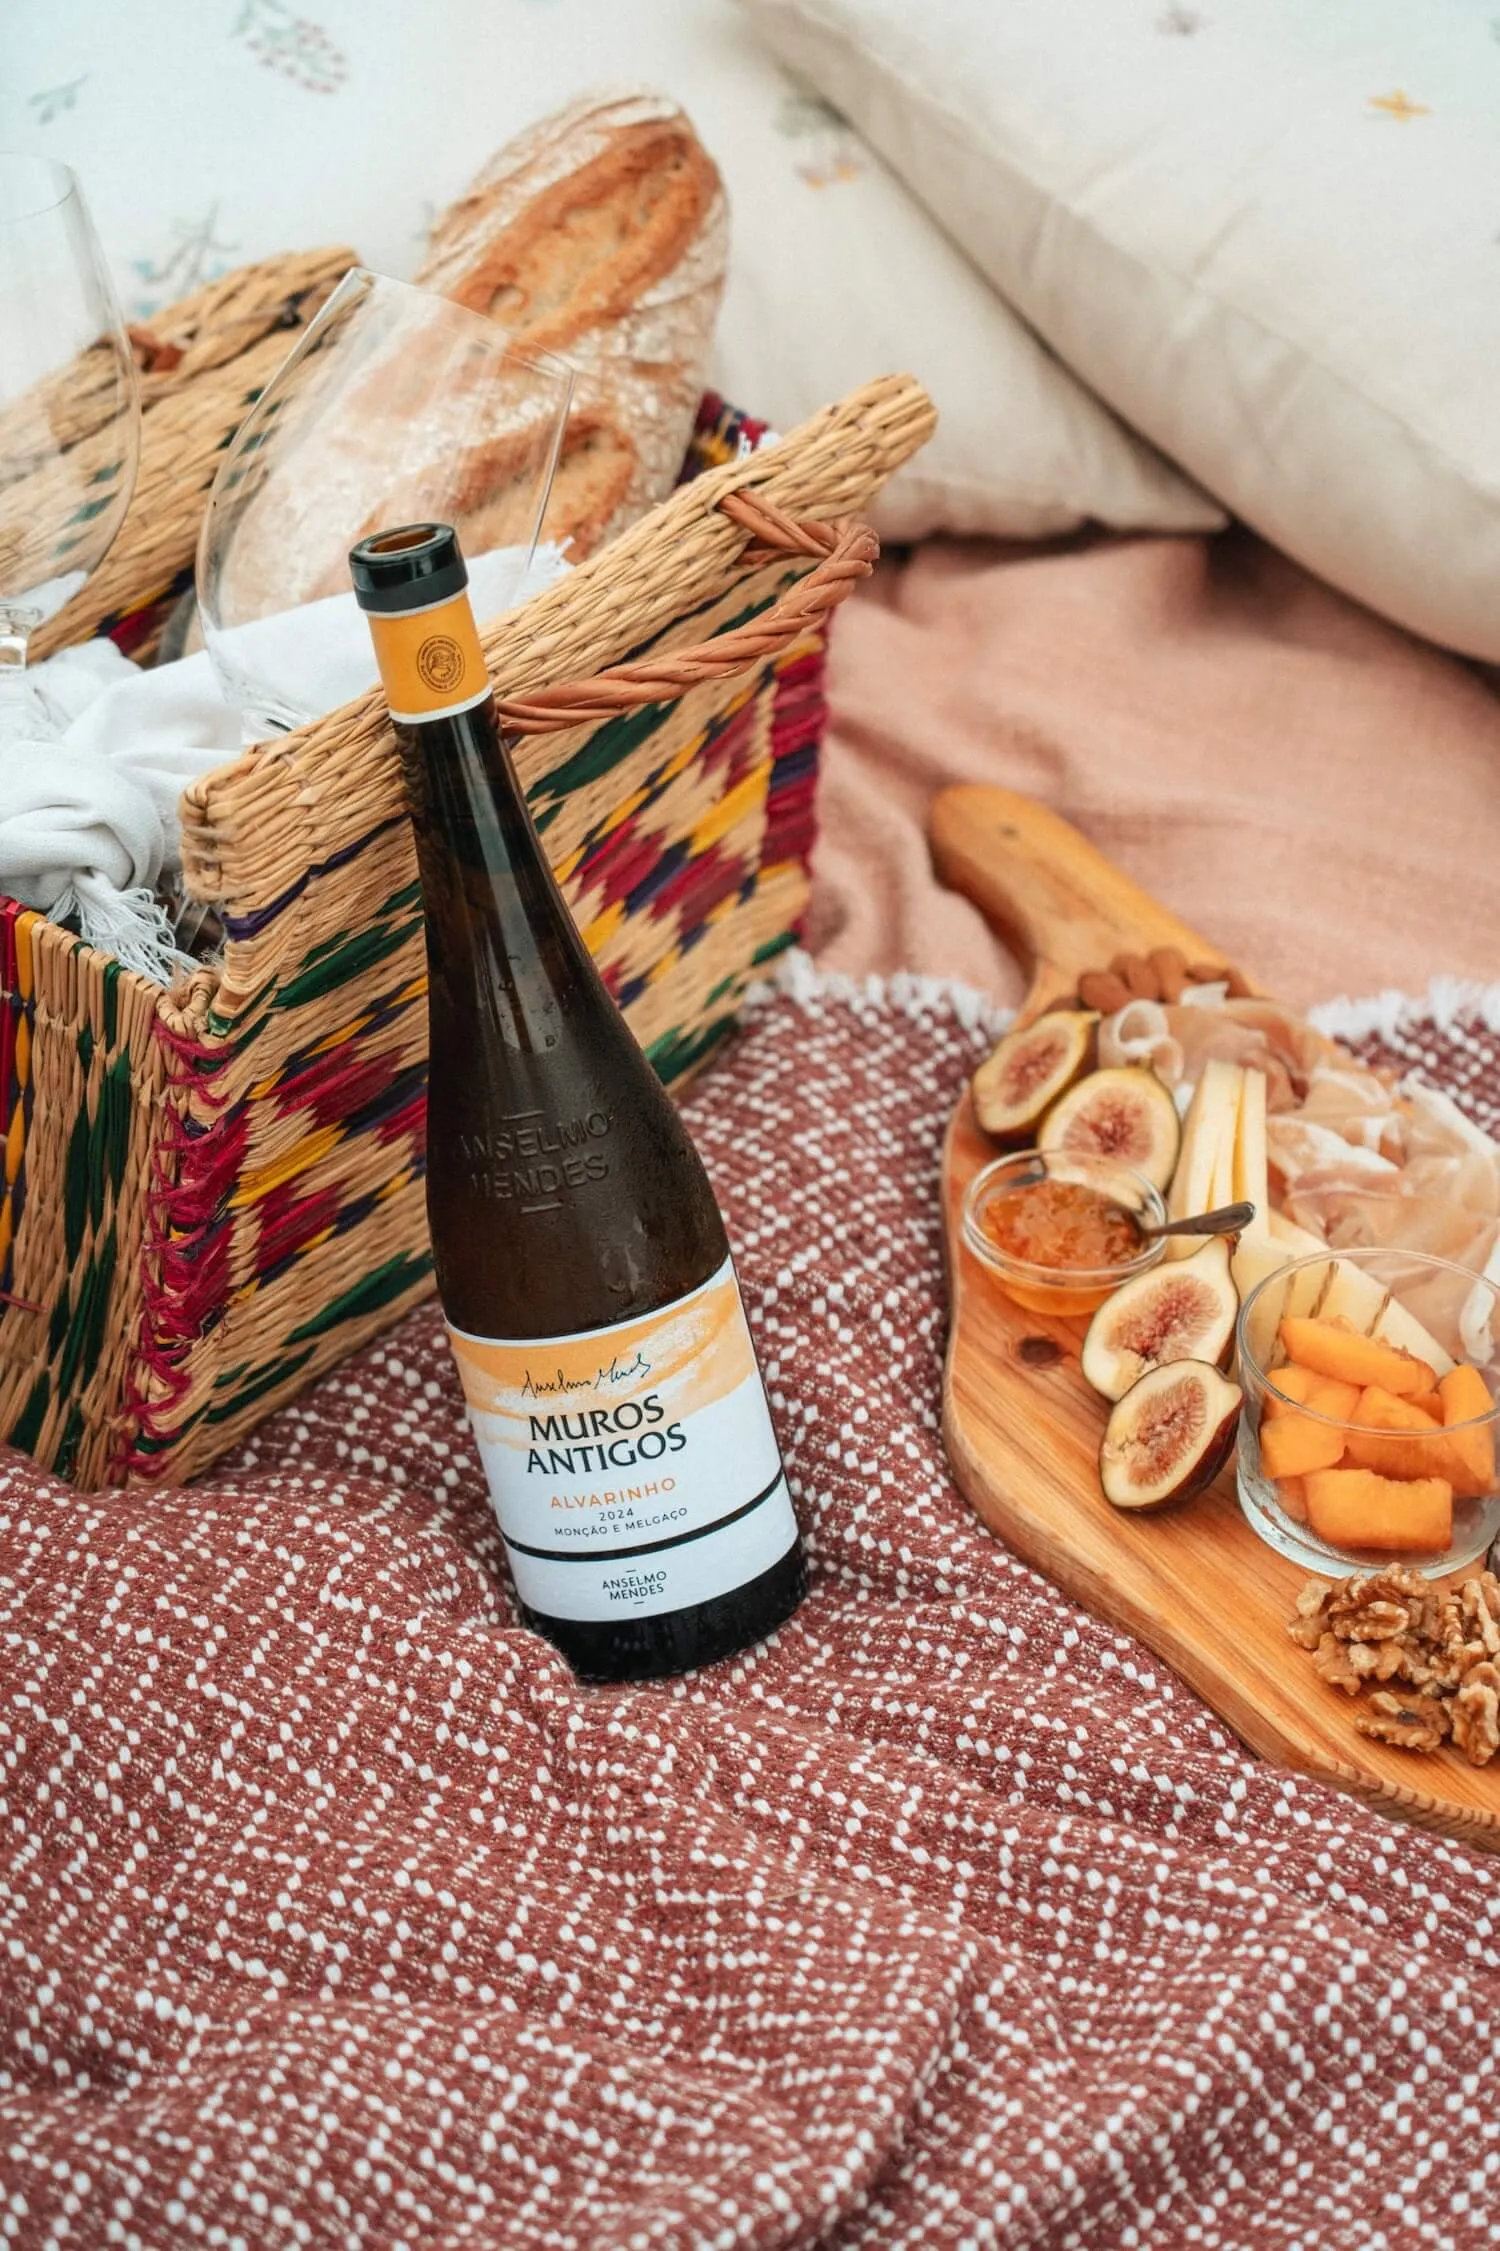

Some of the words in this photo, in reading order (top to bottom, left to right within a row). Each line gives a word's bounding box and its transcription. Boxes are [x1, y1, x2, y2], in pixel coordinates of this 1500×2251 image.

[529, 1394, 665, 1441] MUROS
[527, 1422, 687, 1475] ANTIGOS
[551, 1478, 676, 1509] ALVARINHO
[554, 1525, 608, 1537] MONÇÃO
[613, 1524, 621, 1533] E
[625, 1507, 688, 1531] MELGAÇO
[599, 1507, 635, 1522] 2024
[602, 1570, 667, 1590] ANSELMO
[609, 1583, 665, 1601] MENDES
